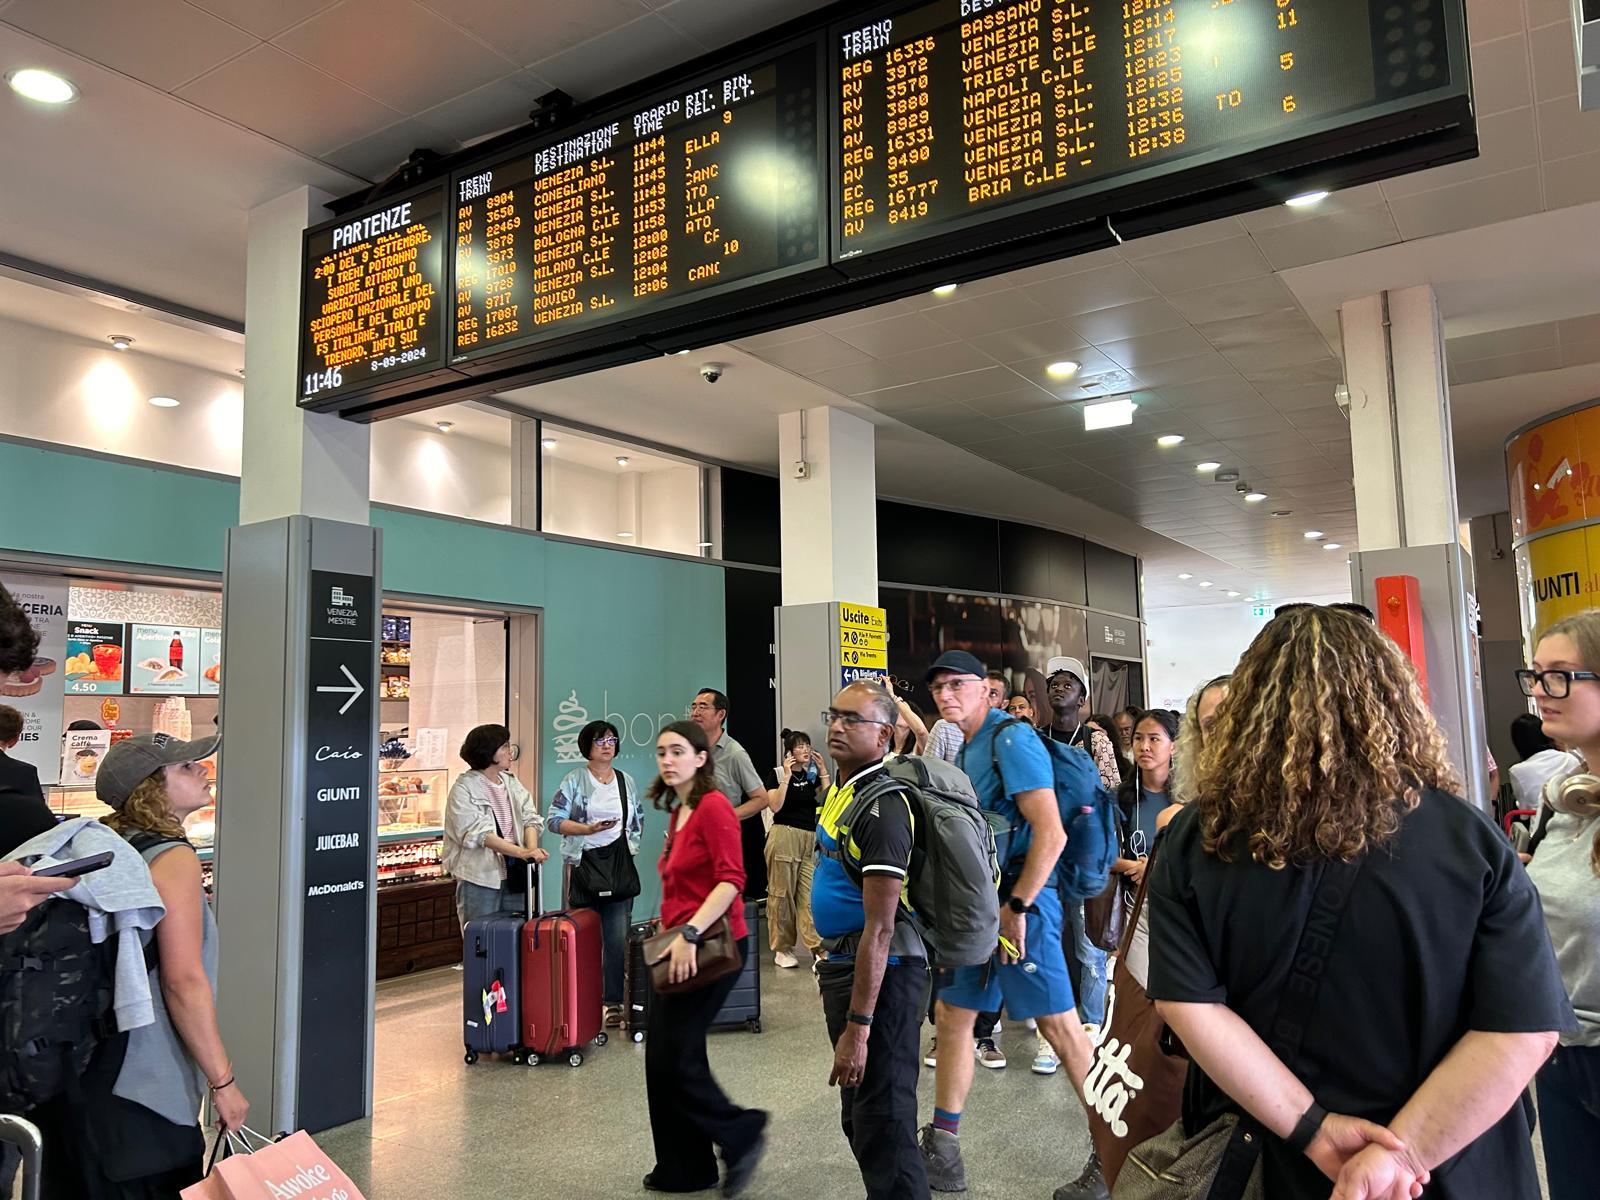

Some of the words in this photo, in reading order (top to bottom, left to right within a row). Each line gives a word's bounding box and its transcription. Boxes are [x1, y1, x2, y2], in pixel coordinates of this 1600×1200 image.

[842, 19, 892, 48] TRENO
[843, 31, 889, 60] TRAIN
[886, 36, 935, 66] 16336
[961, 0, 1041, 39] BASSANO
[886, 56, 928, 82] 3972
[961, 17, 1038, 55] VENEZIA
[1051, 3, 1089, 24] S.L.
[886, 74, 928, 100] 3570
[962, 35, 1039, 74] VENEZIA
[1052, 22, 1090, 43] S.L.
[887, 92, 928, 117] 3880
[962, 53, 1039, 91] TRIESTE
[1052, 34, 1096, 62] C.LE
[1123, 7, 1176, 38] 12:14
[887, 125, 934, 153] 16331
[963, 91, 1041, 128] VENEZIA
[1054, 79, 1092, 100] S.L.
[1277, 8, 1297, 29] 11
[887, 109, 929, 135] 8929
[963, 76, 1028, 110] NAPOLI
[1041, 58, 1084, 85] C.LE
[459, 171, 492, 192] TRENO
[535, 122, 619, 163] DESTINAZIONE
[633, 100, 679, 128] ORARIO
[685, 88, 713, 107] RIT.
[723, 73, 752, 94] BIN.
[459, 182, 490, 202] TRAIN
[535, 136, 611, 175] DESTINATION
[633, 117, 663, 137] TIME
[685, 101, 715, 119] DEL.
[723, 85, 754, 105] PLT.
[843, 166, 863, 185] AV
[887, 145, 930, 171] 9490
[964, 110, 1042, 146] VENEZIA
[1055, 98, 1093, 119] S.L.
[1125, 68, 1181, 98] 12:25
[843, 184, 863, 202] EC
[888, 170, 909, 188] 35
[964, 129, 1042, 165] VENEZIA
[1055, 117, 1094, 138] S.L.
[1126, 87, 1183, 117] 12:32
[486, 190, 514, 209] 8904
[534, 165, 583, 192] VENEZIA
[590, 156, 615, 172] S.L.
[633, 134, 665, 157] 11:44
[486, 204, 514, 223] 3650
[534, 172, 606, 207] CONEGLIANO
[633, 150, 665, 172] 11:44
[844, 198, 874, 220] REG
[888, 179, 938, 206] 16777
[964, 148, 1043, 184] VENEZIA
[1056, 137, 1095, 158] S.L.
[1127, 107, 1184, 137] 12:36
[844, 218, 864, 237] AV
[888, 201, 928, 224] 8419
[968, 177, 1011, 202] BRIA
[1024, 161, 1067, 186] C.LE
[1128, 127, 1185, 158] 12:38
[333, 202, 412, 250] PARTENZE
[486, 216, 521, 238] 22469
[534, 195, 583, 221] VENEZIA
[590, 186, 614, 202] S.L.
[633, 166, 665, 188] 11:45
[486, 233, 514, 251] 3878
[534, 209, 583, 235] VENEZIA
[590, 201, 614, 217] S.L.
[633, 182, 665, 203] 11:49
[339, 255, 357, 271] DEL
[361, 250, 369, 263] 9
[373, 229, 432, 259] SETTEMBRE,
[486, 247, 514, 265] 3973
[534, 224, 585, 251] BOLOGNA
[592, 212, 620, 231] C.LE
[633, 197, 665, 219] 11:53
[533, 240, 583, 265] VENEZIA
[590, 232, 614, 247] S.L.
[633, 213, 666, 234] 11:58
[533, 257, 576, 280] MILANO
[582, 246, 610, 264] C.LE
[633, 228, 668, 250] 12:00
[327, 275, 332, 288] I
[336, 264, 364, 284] TRENI
[368, 247, 417, 274] POTRANNO
[327, 279, 361, 300] SUBIRE
[365, 264, 404, 288] RITARDI
[408, 261, 416, 274] O
[485, 291, 511, 309] 9717
[534, 270, 583, 294] VENEZIA
[590, 262, 614, 278] S.L.
[633, 244, 668, 265] 12:02
[485, 304, 518, 324] 17087
[533, 287, 576, 310] ROVIGO
[633, 260, 668, 281] 12:04
[724, 239, 739, 255] 10
[310, 308, 354, 332] SCIOPERO
[357, 289, 410, 317] NAZIONALE
[415, 282, 435, 299] DEL
[321, 287, 374, 315] VARIAZIONI
[378, 280, 398, 297] PER
[402, 272, 422, 289] UNO
[486, 320, 518, 338] 16232
[534, 301, 583, 324] VENEZIA
[590, 294, 614, 308] S.L.
[633, 276, 668, 296] 12:06
[313, 317, 364, 344] PERSONALE
[368, 311, 388, 327] DEL
[392, 297, 431, 320] GRUPPO
[316, 342, 329, 356] FS
[332, 327, 379, 351] ITALIANE,
[383, 316, 414, 336] ITALO
[418, 312, 426, 326] E
[324, 345, 368, 366] TRENORD.
[372, 335, 395, 353] INFO
[400, 329, 418, 345] SUI
[371, 347, 426, 371] 8-09-2024
[305, 365, 342, 395] 11:46
[74, 626, 99, 634] Snack
[327, 608, 358, 617] VENEZIA
[327, 617, 357, 625] MESTRE
[842, 608, 869, 625] Uscite
[72, 683, 97, 692] 4.50
[315, 746, 363, 761] Caio
[317, 787, 360, 802] GIUNTI
[315, 833, 359, 851] JUICEBAR
[308, 881, 364, 897] McDonald's
[264, 1164, 330, 1200] Awoke
